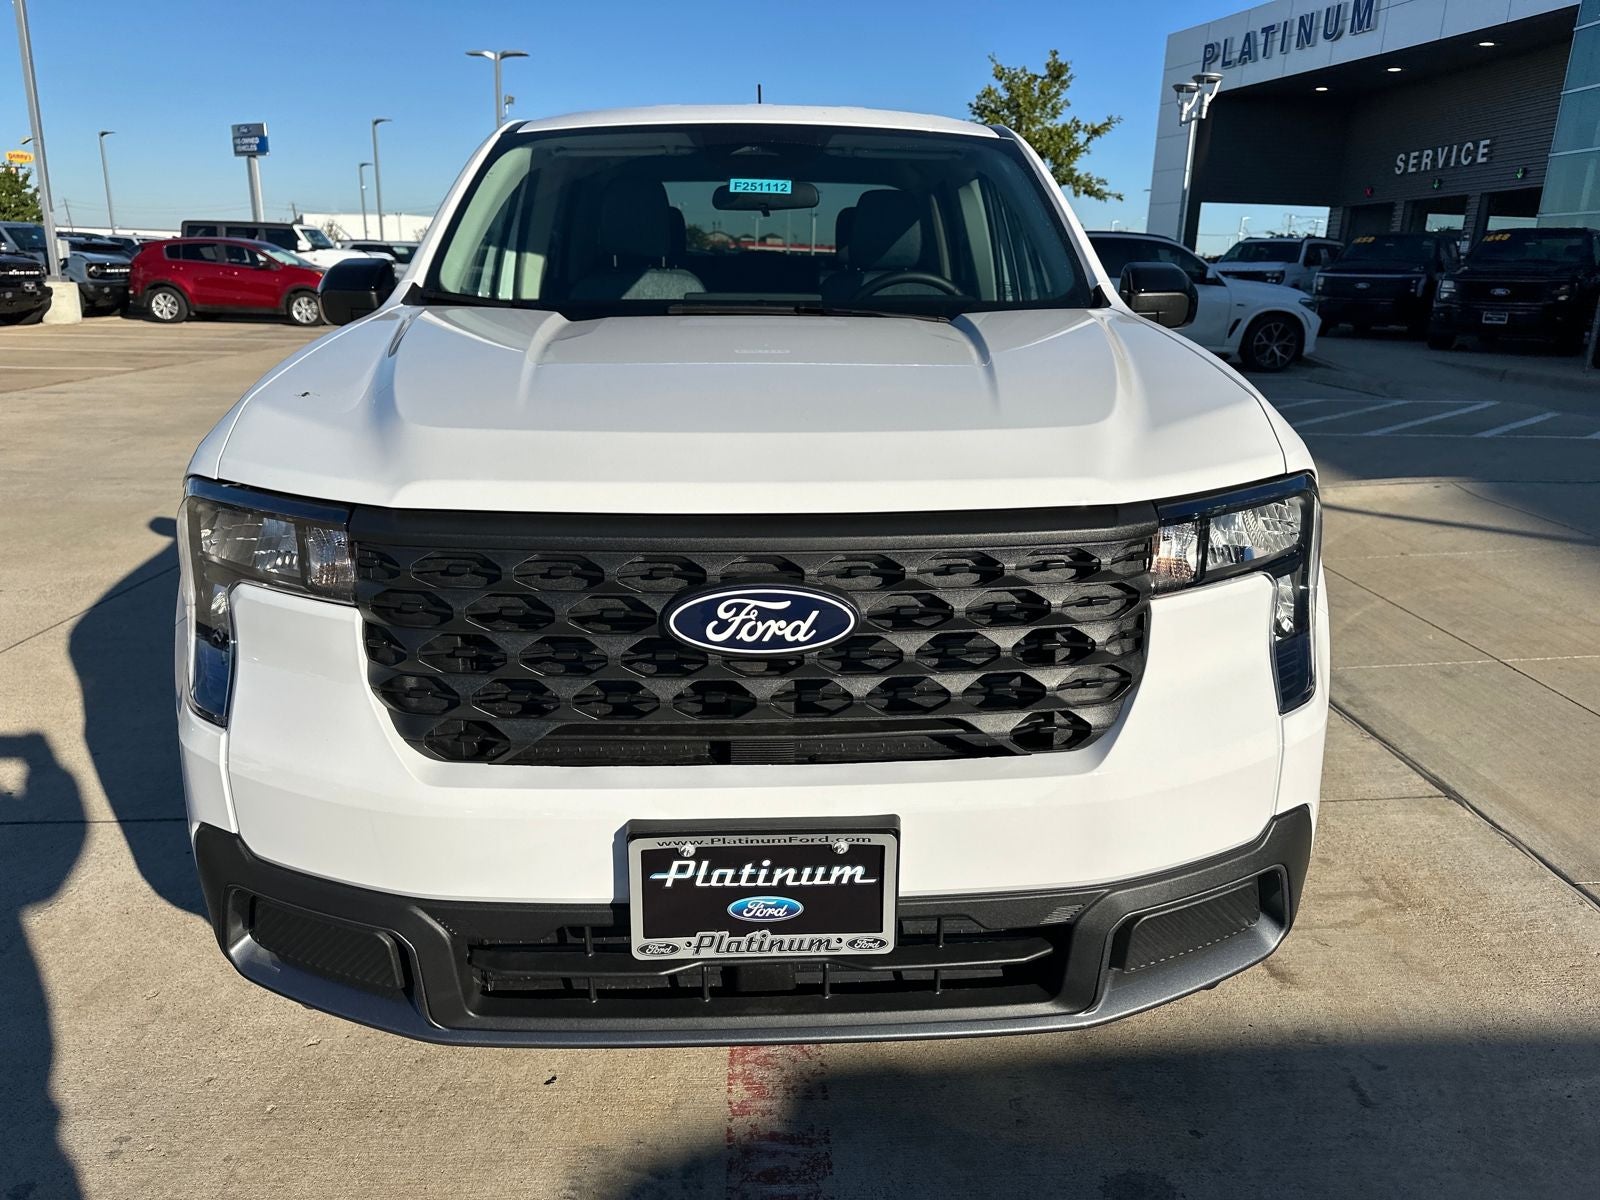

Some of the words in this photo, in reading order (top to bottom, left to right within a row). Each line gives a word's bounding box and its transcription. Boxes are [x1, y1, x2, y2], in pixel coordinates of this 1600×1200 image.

[1202, 0, 1376, 74] PLATINUM
[1394, 139, 1491, 174] SERVICE
[734, 181, 788, 192] F251112
[705, 598, 820, 643] Ford
[656, 835, 872, 847] www.PlatinumFord.com
[650, 859, 878, 888] Platinum
[742, 899, 788, 918] Ford
[645, 943, 673, 955] Ford
[693, 931, 843, 956] Platinum
[853, 937, 881, 950] Ford
